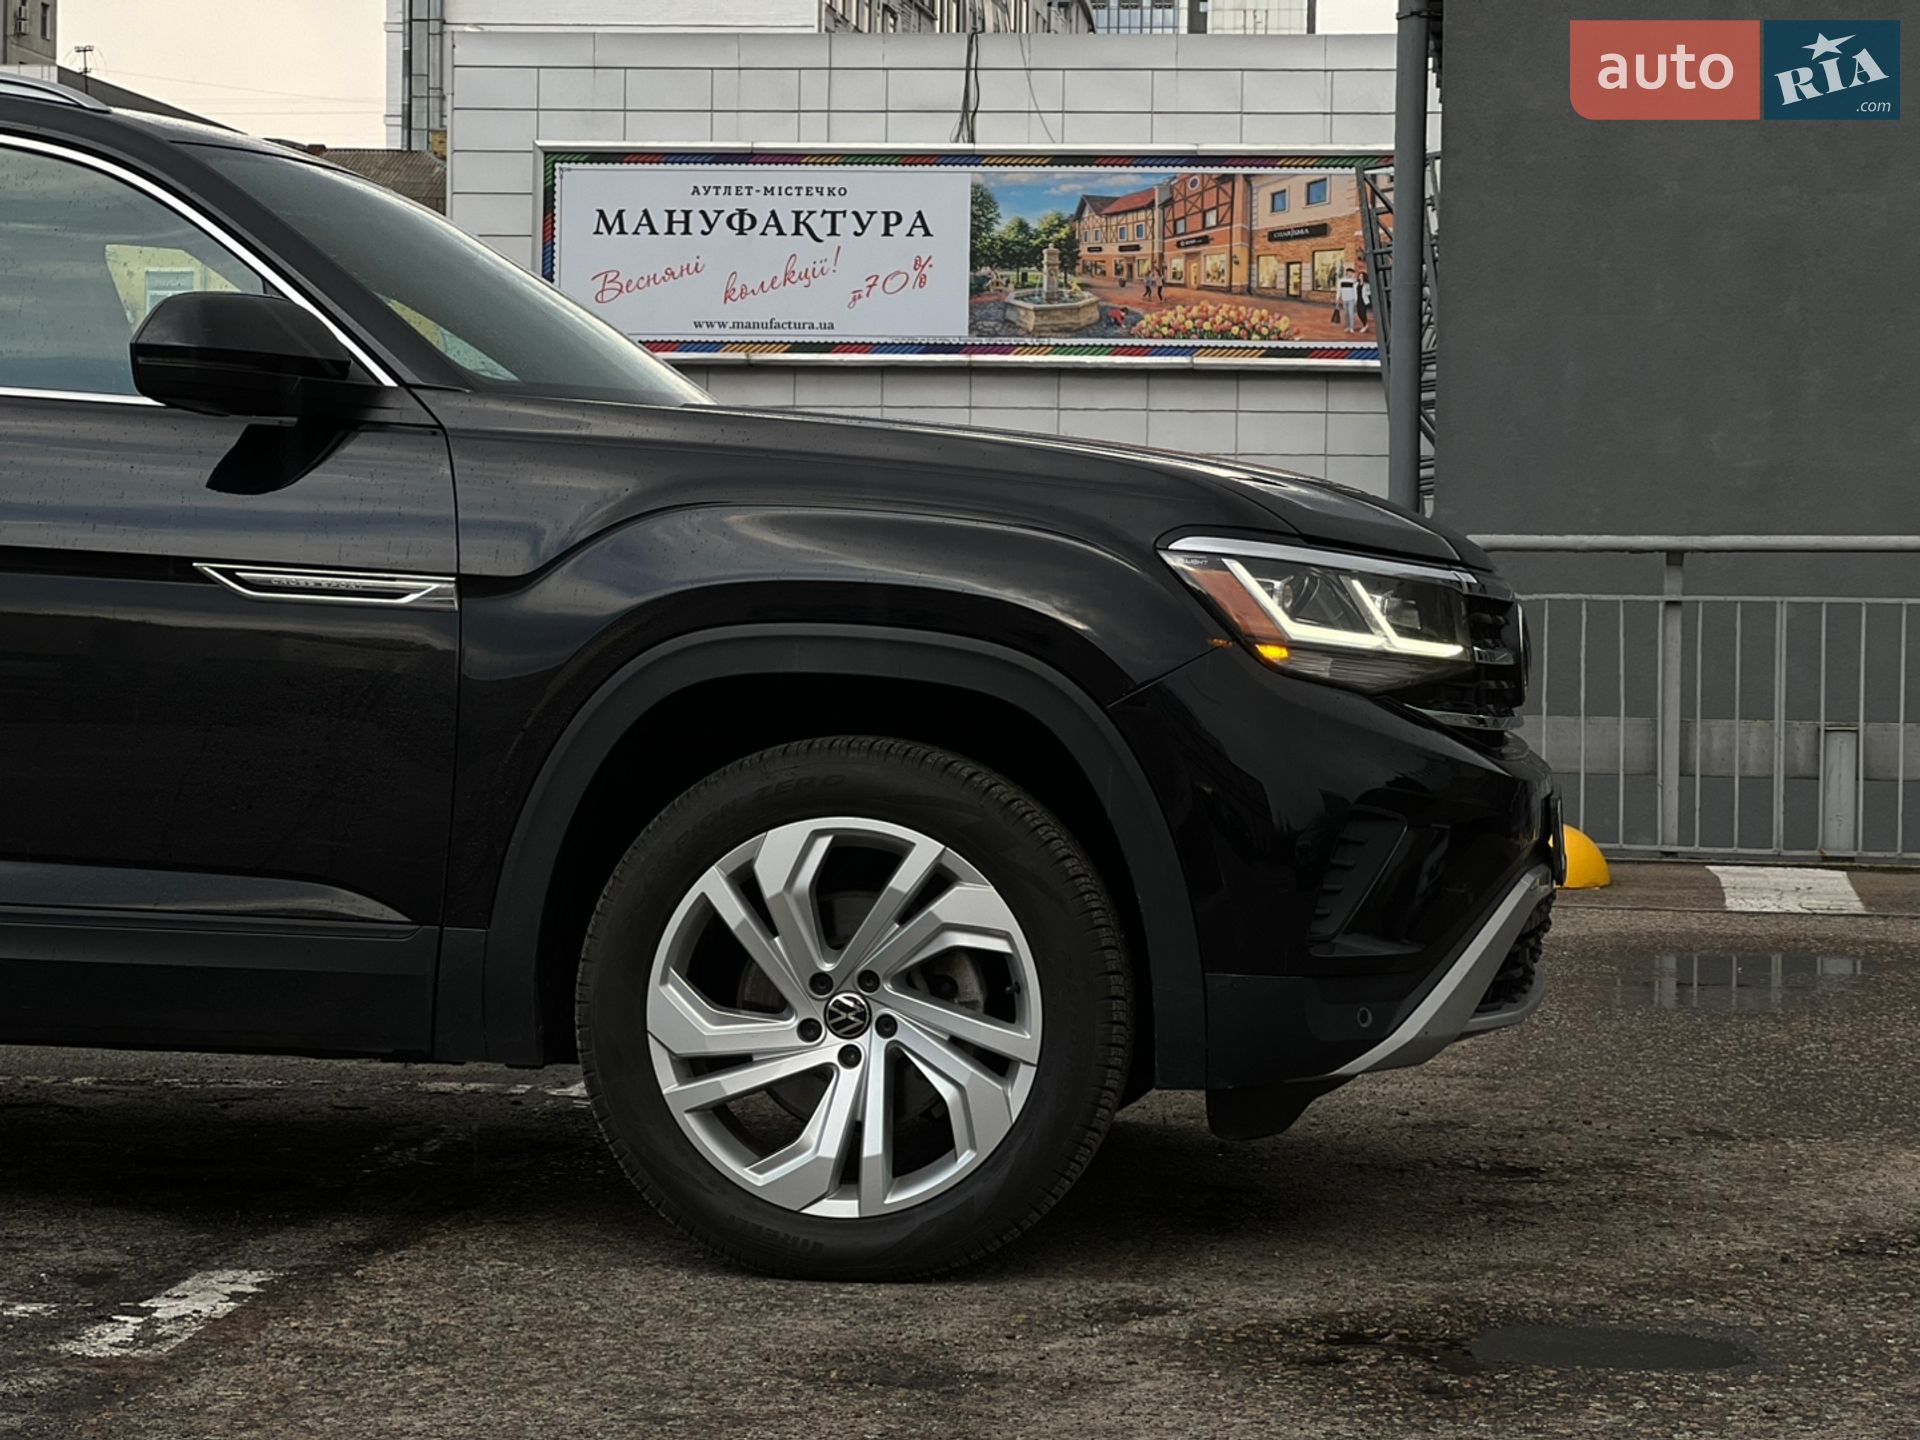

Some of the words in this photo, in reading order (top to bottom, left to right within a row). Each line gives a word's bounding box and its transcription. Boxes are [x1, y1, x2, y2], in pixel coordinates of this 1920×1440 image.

[690, 184, 849, 197] АУТЛЕТ-МІСТЕЧКО
[592, 207, 934, 243] МАНУФАКТУРА
[591, 255, 706, 304] Весняні
[723, 245, 842, 304] колекції!
[692, 317, 836, 332] www.manufactura.ua
